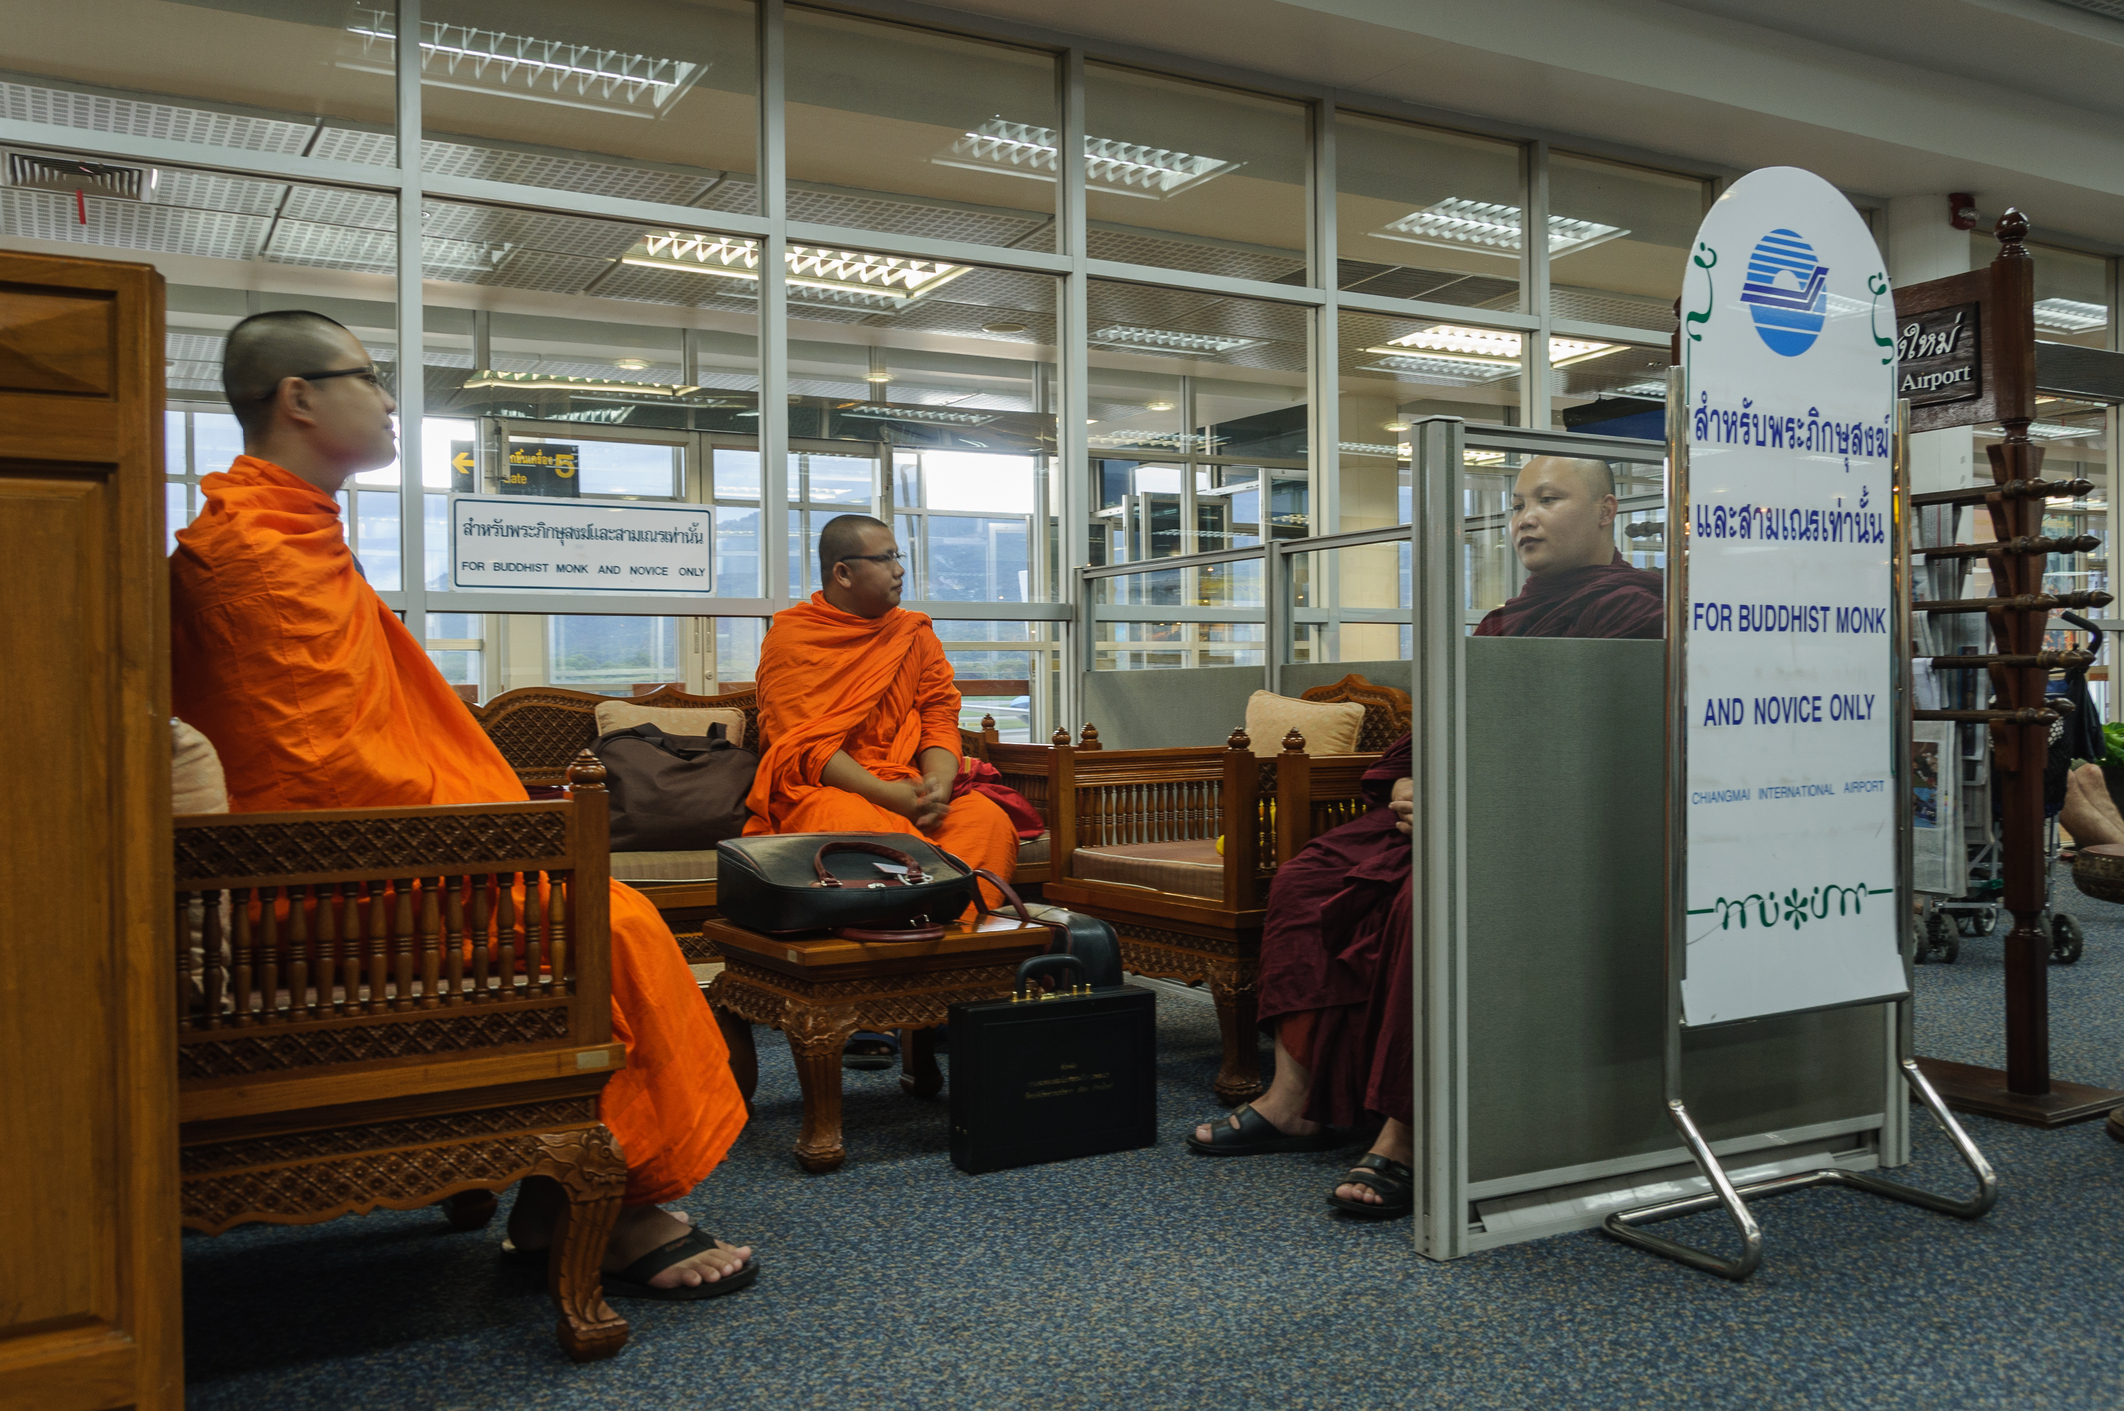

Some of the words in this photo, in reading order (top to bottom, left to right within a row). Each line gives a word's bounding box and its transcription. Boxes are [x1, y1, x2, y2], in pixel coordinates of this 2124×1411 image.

[1900, 366, 1972, 391] Airport
[1693, 390, 1890, 473] สำหรับพระภิกษุสงฆ์
[504, 473, 528, 485] ate
[555, 453, 575, 479] 5
[1697, 485, 1885, 544] และสามเณรเท่านั้น
[463, 517, 704, 546] สำหรับพระภิกษุสงฆ์และสามเณรเท่านั้น
[462, 561, 485, 571] FOR
[493, 562, 549, 573] BUDDHIST
[556, 563, 589, 574] MONK
[597, 565, 621, 575] AND
[629, 565, 669, 576] NOVICE
[679, 567, 706, 577] ONLY
[1693, 602, 1732, 632] FOR
[1739, 604, 1831, 633] BUDDHIST
[1836, 607, 1887, 634] MONK
[1704, 697, 1744, 727] AND
[1754, 695, 1822, 725] NOVICE
[1830, 693, 1875, 722] ONLY
[1691, 788, 1750, 805] CHIANGMAI
[1758, 783, 1835, 800] INTERNATIONAL
[1843, 780, 1885, 794] AIRPORT
